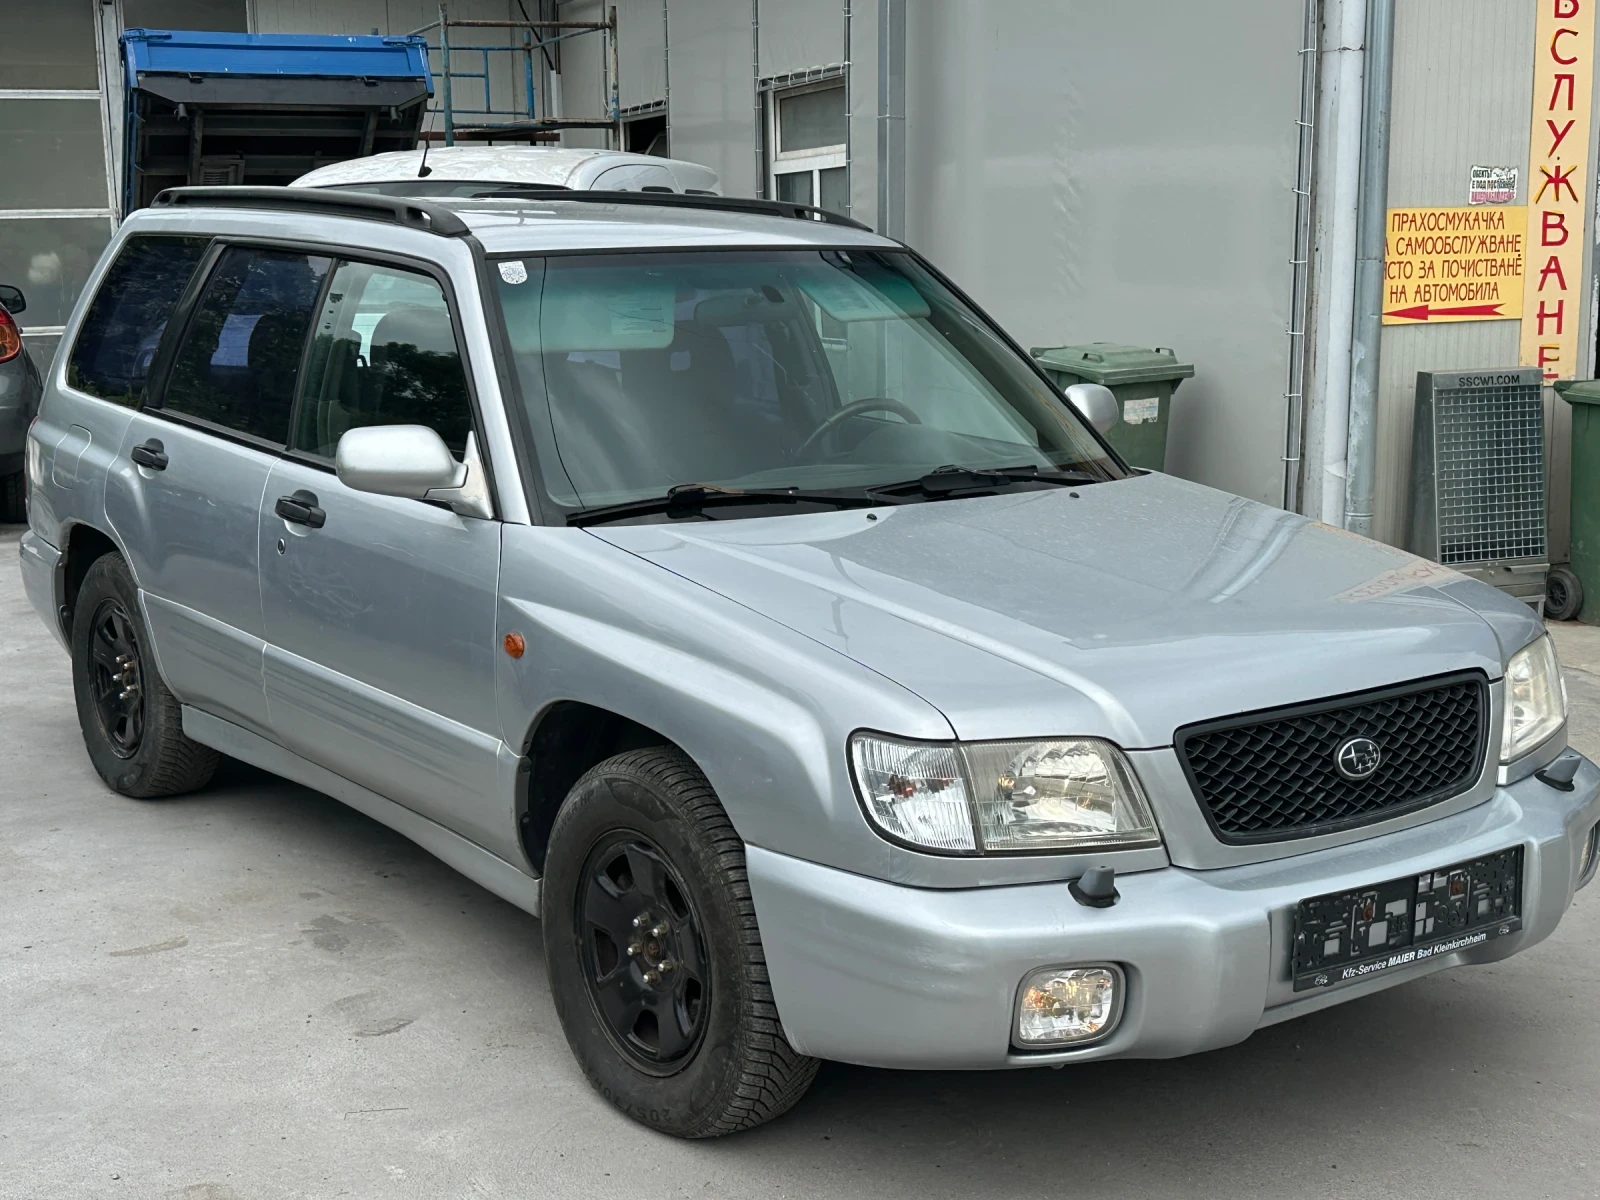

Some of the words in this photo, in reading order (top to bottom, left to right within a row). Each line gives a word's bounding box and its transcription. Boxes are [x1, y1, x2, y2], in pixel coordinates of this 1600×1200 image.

[1391, 211, 1505, 232] ПРАХОСМУКАЧКА
[1396, 234, 1522, 255] САМООБСЛУЖВАНЕ
[1418, 260, 1435, 279] ЗА
[1441, 258, 1522, 278] ПОЧИСТВАНЕ
[1390, 284, 1408, 303] НА
[1413, 282, 1500, 302] АВТОМОБИЛА
[1458, 374, 1520, 387] SSCW1.COM
[1342, 960, 1387, 979] Kfz-Service
[1388, 951, 1415, 967] MAIER
[1417, 945, 1433, 959] Bad
[1433, 932, 1487, 955] Kleinkirchheim
